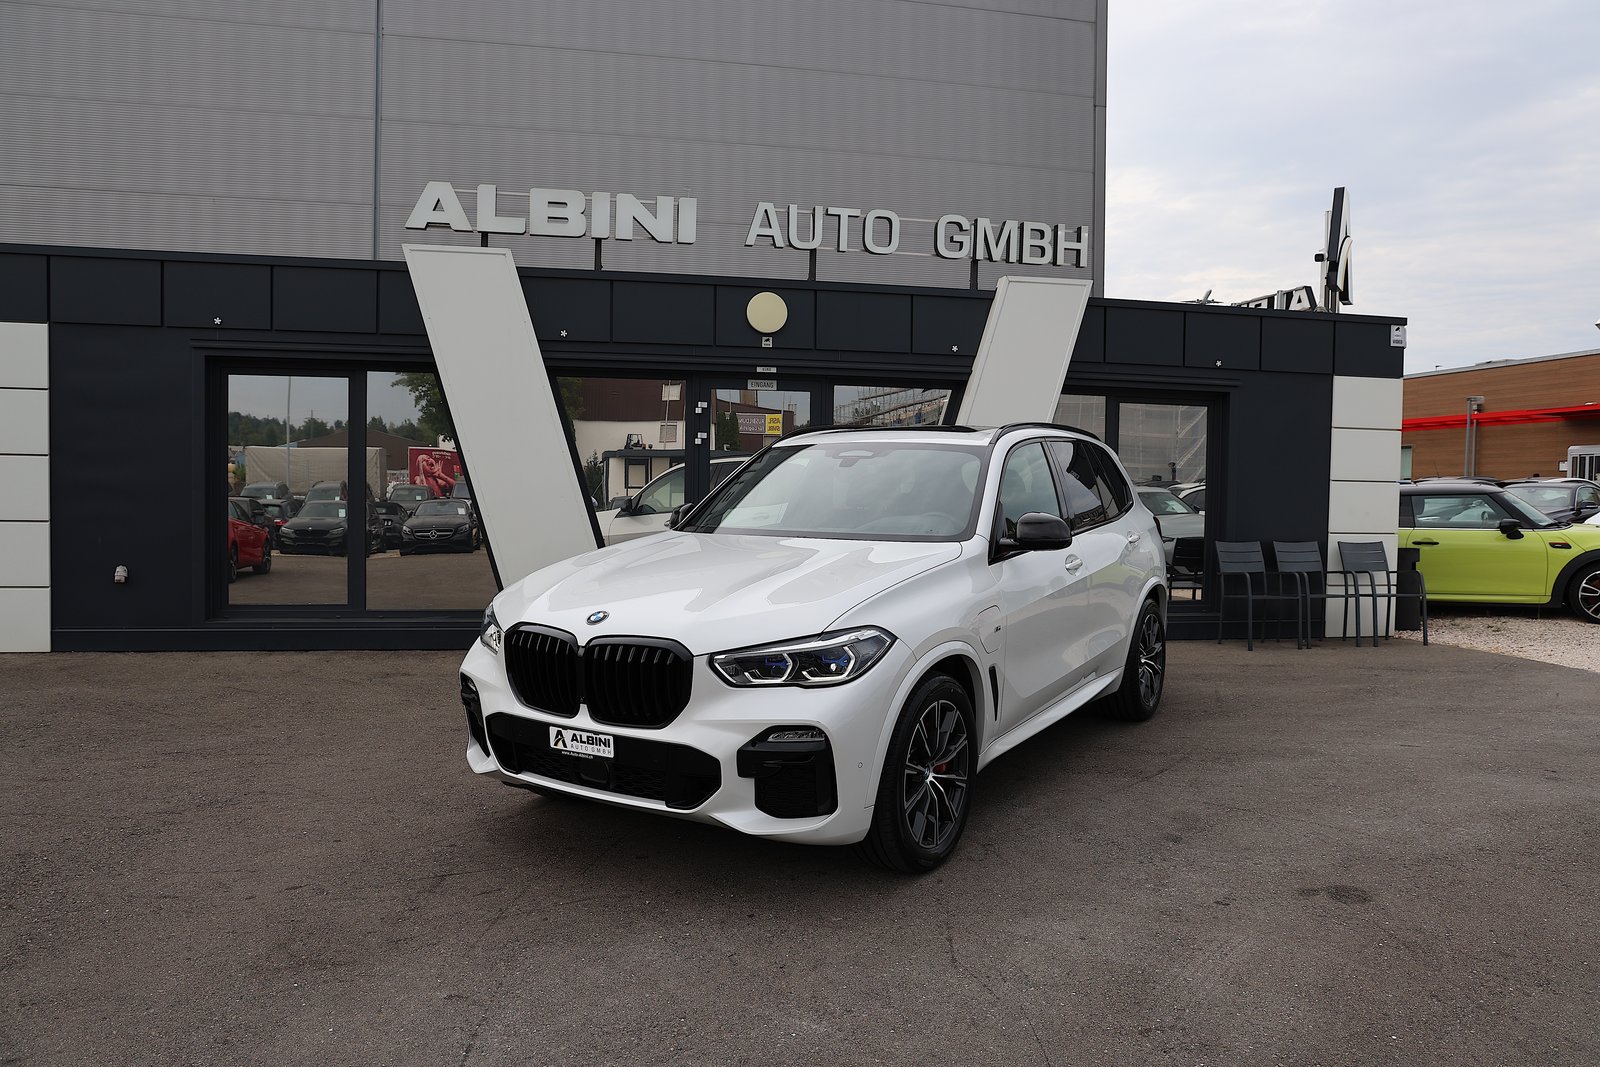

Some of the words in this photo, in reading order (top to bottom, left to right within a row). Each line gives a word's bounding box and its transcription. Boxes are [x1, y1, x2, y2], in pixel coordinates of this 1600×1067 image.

[404, 181, 698, 244] ALBINI
[744, 202, 901, 255] AUTO
[934, 214, 1089, 268] GMBH
[570, 733, 611, 748] ALBINI
[570, 743, 589, 752] AUTO
[591, 747, 612, 755] GMBH
